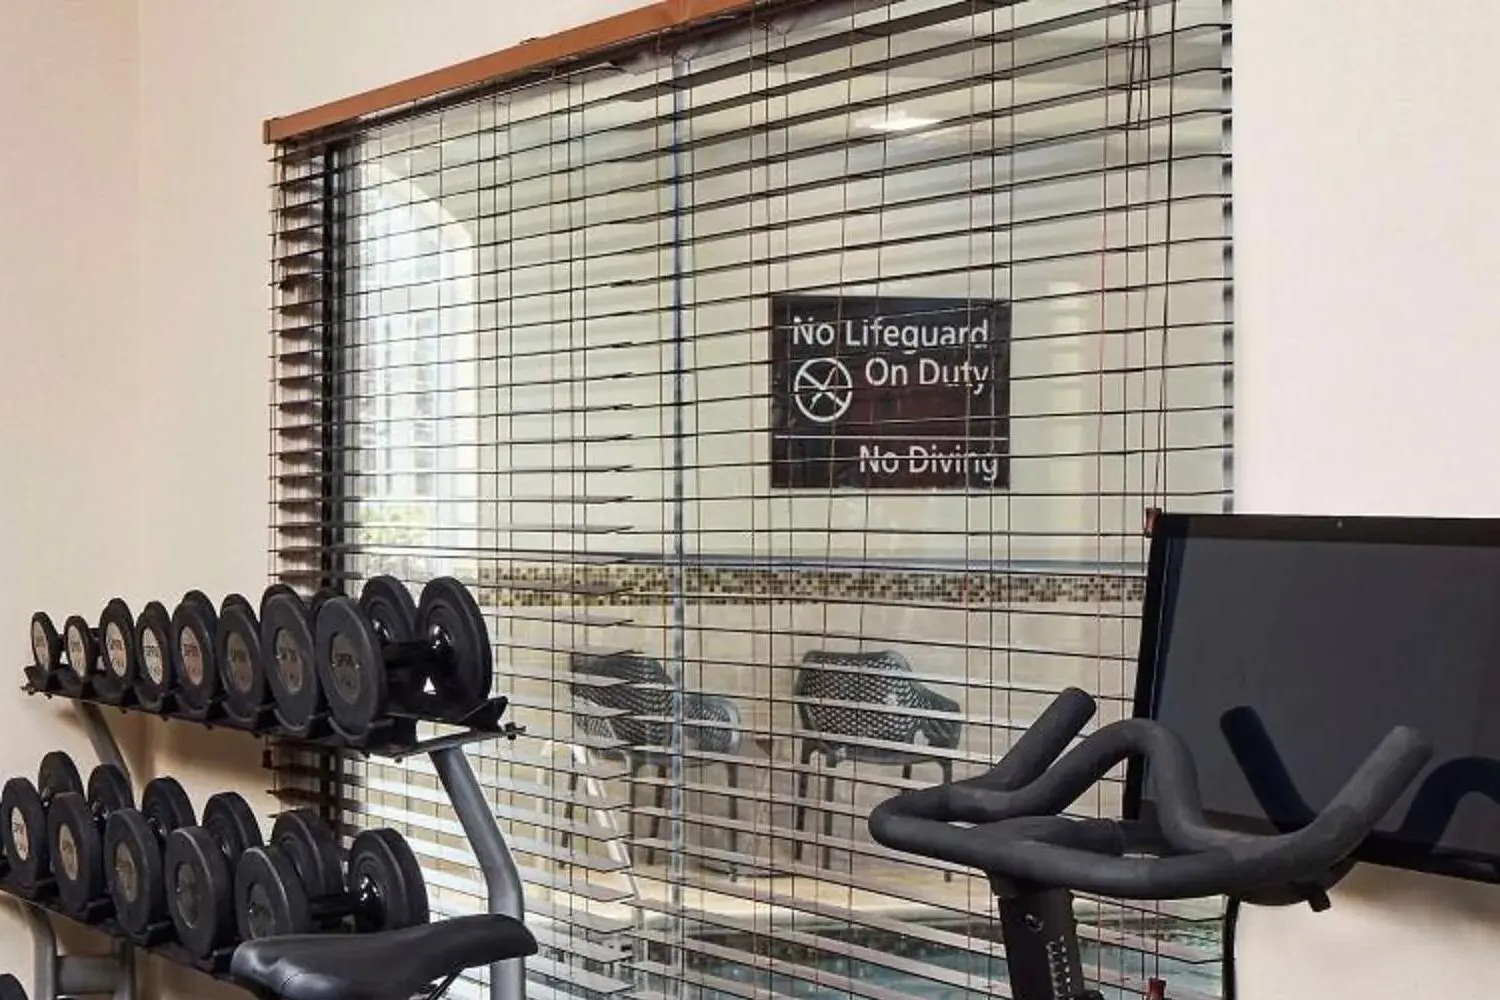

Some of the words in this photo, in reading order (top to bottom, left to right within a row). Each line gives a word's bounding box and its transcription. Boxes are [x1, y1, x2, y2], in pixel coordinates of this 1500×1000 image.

[792, 317, 835, 346] No
[845, 316, 988, 354] Lifeguard
[865, 357, 908, 387] On
[919, 358, 989, 394] Duty
[859, 445, 900, 474] No
[909, 444, 999, 481] Diving
